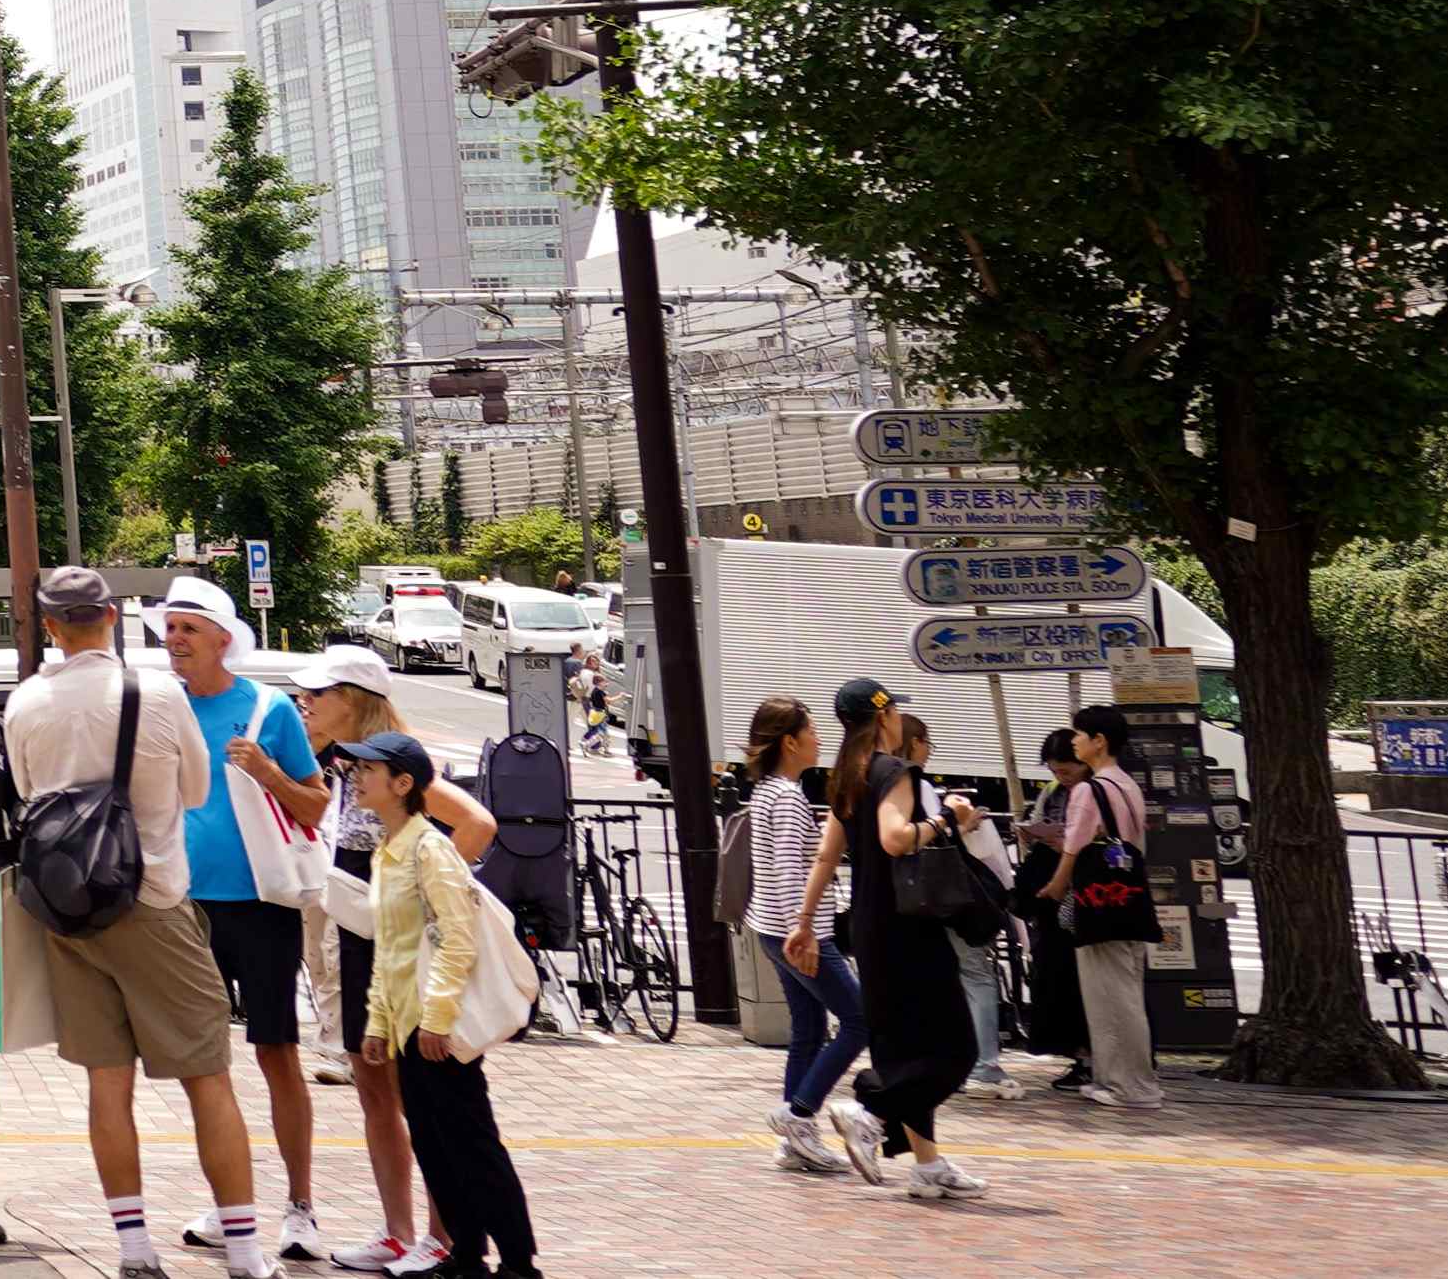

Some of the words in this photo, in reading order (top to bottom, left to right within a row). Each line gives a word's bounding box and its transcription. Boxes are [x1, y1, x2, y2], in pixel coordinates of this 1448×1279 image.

[927, 488, 1105, 510] 東京医科大学病院
[931, 514, 961, 524] Tokyo
[966, 513, 1006, 523] Medical
[1012, 514, 1063, 526] University
[250, 545, 267, 579] P
[967, 556, 1079, 579] 新宿警察署
[1023, 582, 1061, 593] POLICE
[1092, 579, 1131, 593] 500m
[976, 626, 1088, 647] 新宿区役所
[1031, 650, 1054, 664] City
